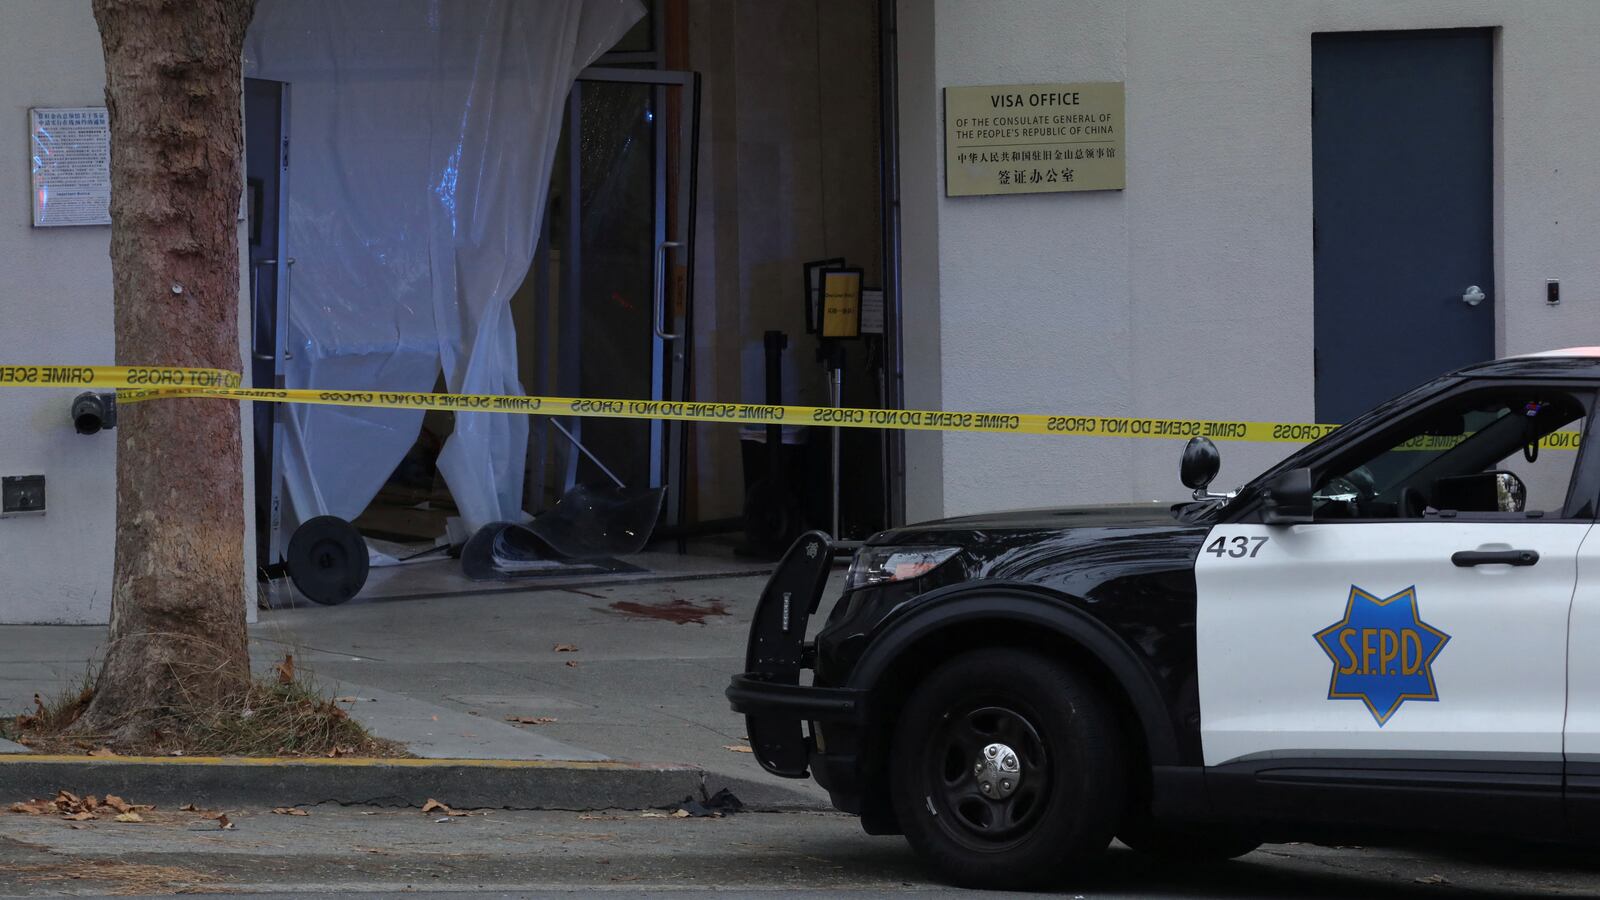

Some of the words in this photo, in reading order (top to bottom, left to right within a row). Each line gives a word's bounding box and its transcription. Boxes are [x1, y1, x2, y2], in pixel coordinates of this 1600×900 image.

[991, 95, 1024, 108] VISA
[1029, 92, 1080, 107] OFFICE
[956, 118, 969, 127] OF
[972, 118, 989, 126] THE
[993, 115, 1050, 126] CONSULATE
[1052, 114, 1096, 124] GENERAL
[1099, 113, 1112, 122] OF
[956, 130, 974, 139] THE
[977, 128, 1019, 138] PEOPLE'S
[1023, 126, 1067, 137] REPUBLIC
[1069, 126, 1081, 135] OF
[1084, 125, 1114, 134] CHINA
[957, 148, 1116, 164] 中华人民共和国驻旧金山总领事馆
[998, 168, 1075, 184] 签证办公室
[1206, 536, 1269, 558] 437
